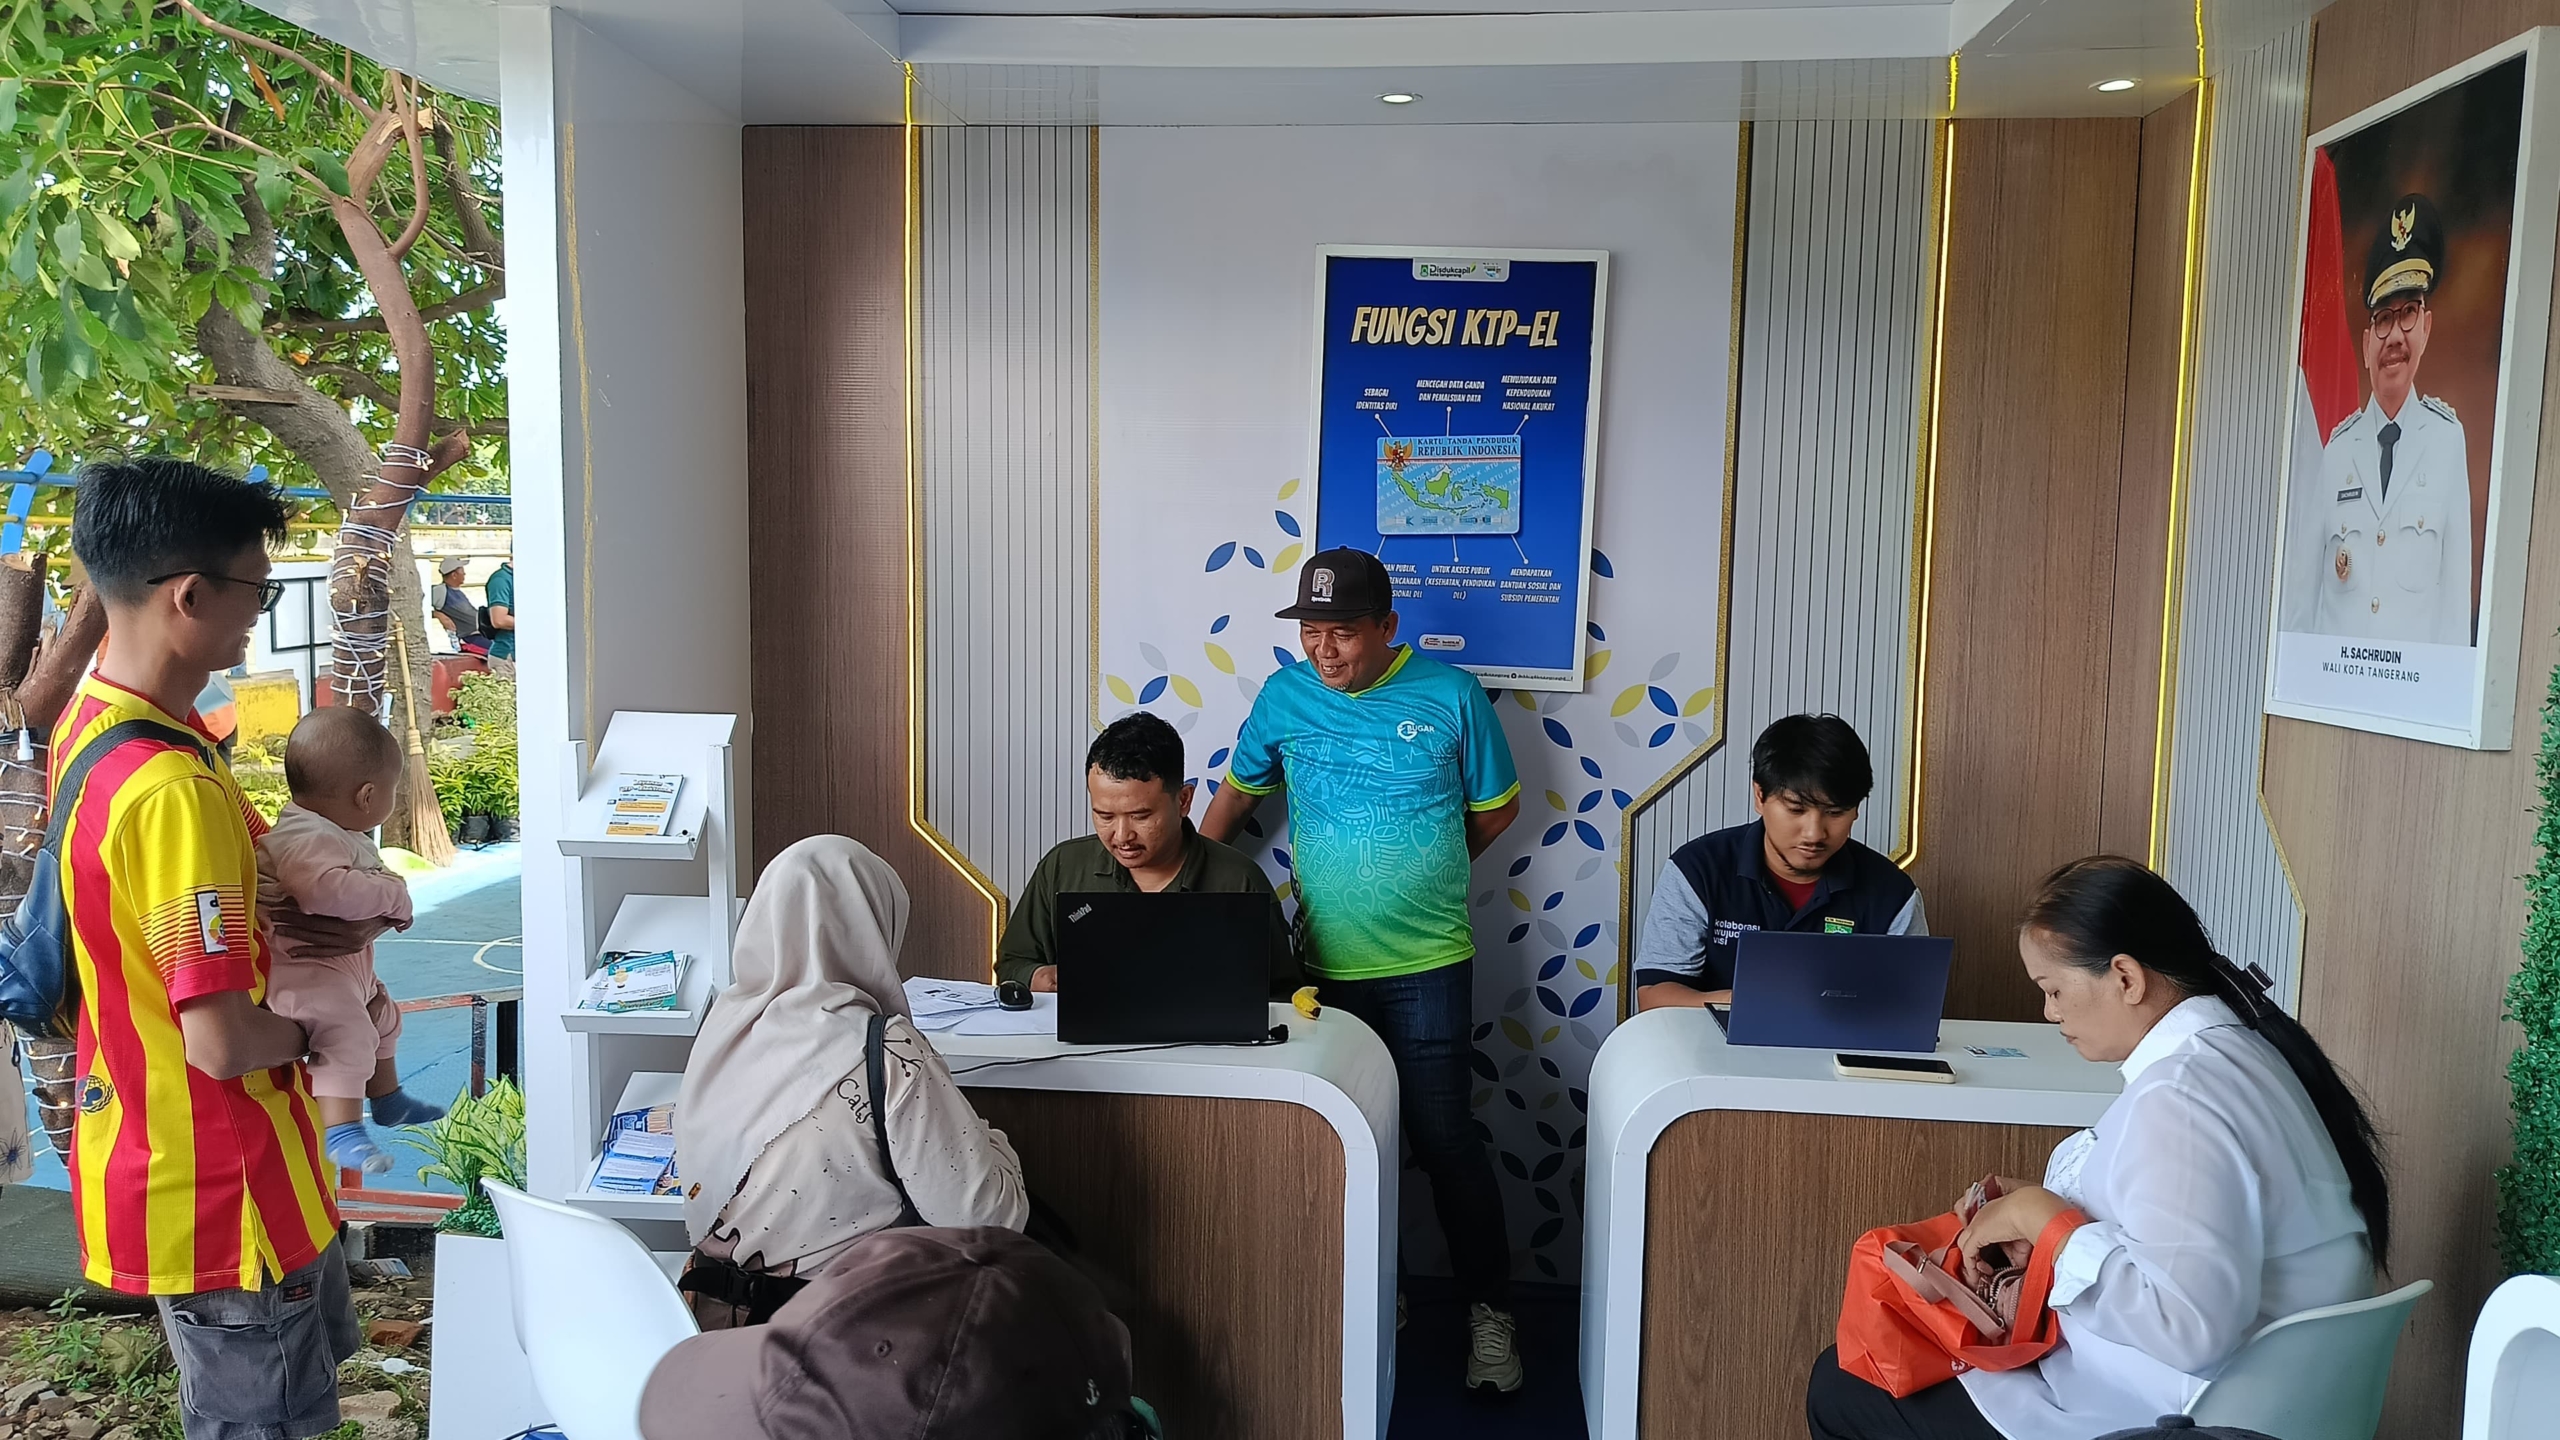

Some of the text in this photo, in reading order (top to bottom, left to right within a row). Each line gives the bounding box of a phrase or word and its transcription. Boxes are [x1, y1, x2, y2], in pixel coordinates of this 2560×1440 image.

[1429, 264, 1471, 275] Disdukcapil
[1350, 305, 1560, 348] FUNGSI KTP-EL
[1416, 379, 1485, 390] MENCEGAH DATA GANDA
[1501, 375, 1557, 385] MEWUJUDKAN DATA
[1364, 388, 1390, 397] SEBAGAI
[1505, 388, 1551, 398] KEPENDUDUKAN
[1418, 393, 1481, 403] DAN PEMALSUAN DATA
[1355, 401, 1398, 411] IDENTITAS DIRI
[1502, 401, 1556, 411] NASIONAL AKURAT
[1417, 436, 1518, 446] KARTU TANDA PENDUDUK
[1417, 445, 1518, 456] REPUBLIK INDONESIA
[1395, 564, 1417, 574] PUBLIK,
[1431, 565, 1491, 575] UNTUK AKSES PUBLIK
[1510, 568, 1553, 578] MENDAPATKAN
[1389, 577, 1422, 585] RENCANAAN
[1425, 577, 1497, 588] (KESEHATAN, PENDIDIKAN
[1500, 580, 1562, 591] BANTUAN SOSIAL DAN
[1392, 589, 1412, 598] SIONAL
[1500, 593, 1560, 604] SUBSIDI PEMERINTAH
[2340, 646, 2402, 664] H. SACHRUDIN
[2322, 661, 2420, 683] WALI KOTA TANGERANG
[1068, 902, 1093, 924] ThinkPad
[1714, 918, 1761, 931] kolaborasi
[1713, 936, 1728, 946] visi
